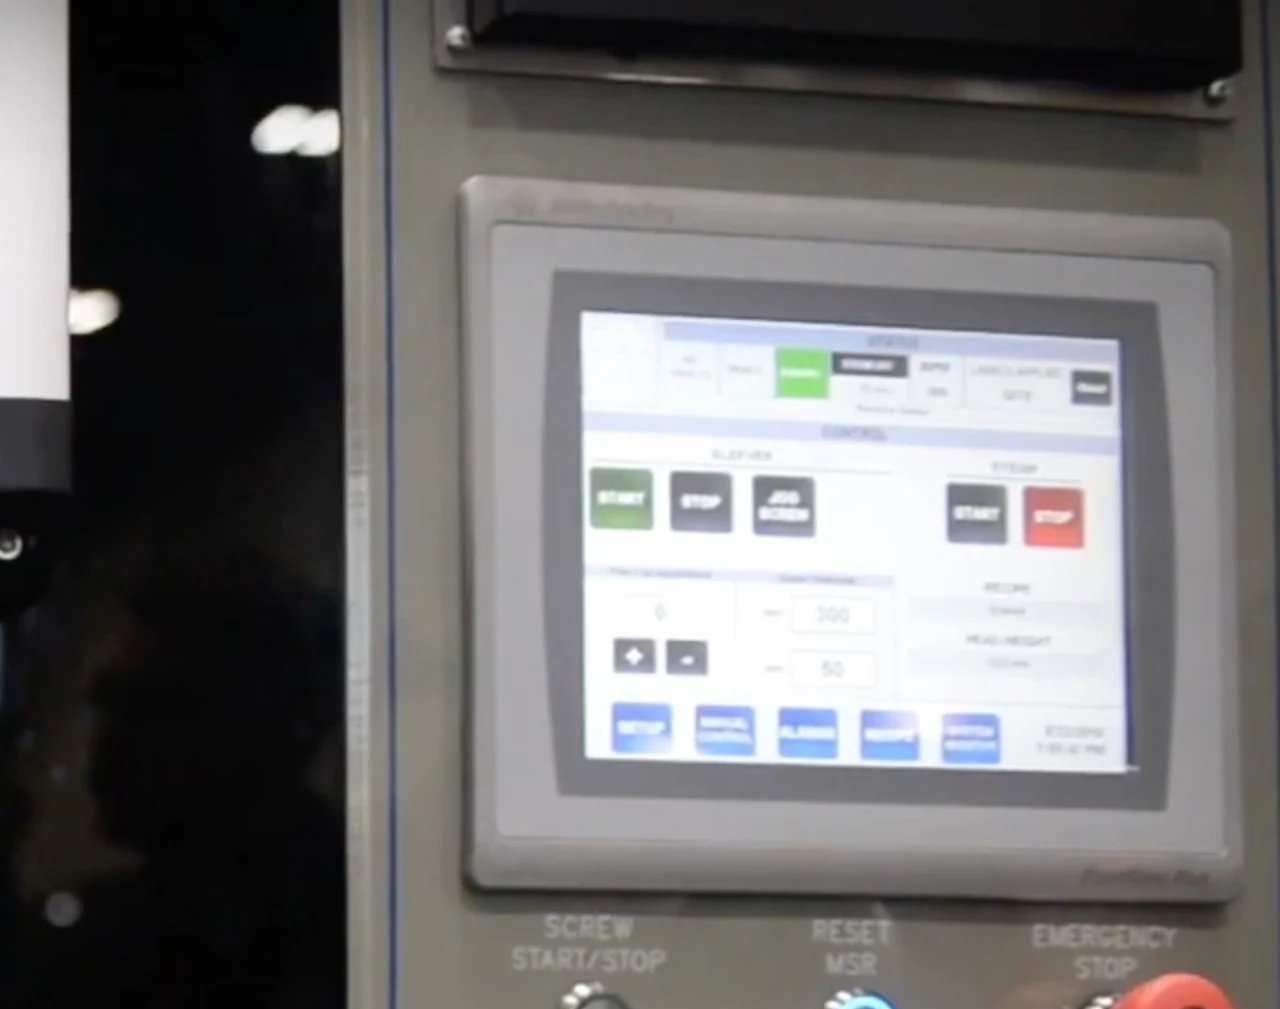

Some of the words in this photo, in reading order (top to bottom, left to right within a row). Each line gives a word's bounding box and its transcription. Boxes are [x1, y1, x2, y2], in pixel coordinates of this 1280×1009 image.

[596, 490, 645, 506] START
[680, 493, 722, 510] STOP
[768, 489, 801, 505] JOG
[952, 505, 1001, 521] START
[1032, 509, 1074, 525] STOP
[816, 605, 851, 624] 300
[821, 659, 845, 678] 50
[544, 913, 635, 941] SCREW
[811, 918, 892, 946] RESET
[1031, 923, 1179, 949] EMERGENCY
[511, 946, 667, 974] START/STOP
[825, 951, 878, 977] MSR
[1073, 955, 1138, 980] STOP
